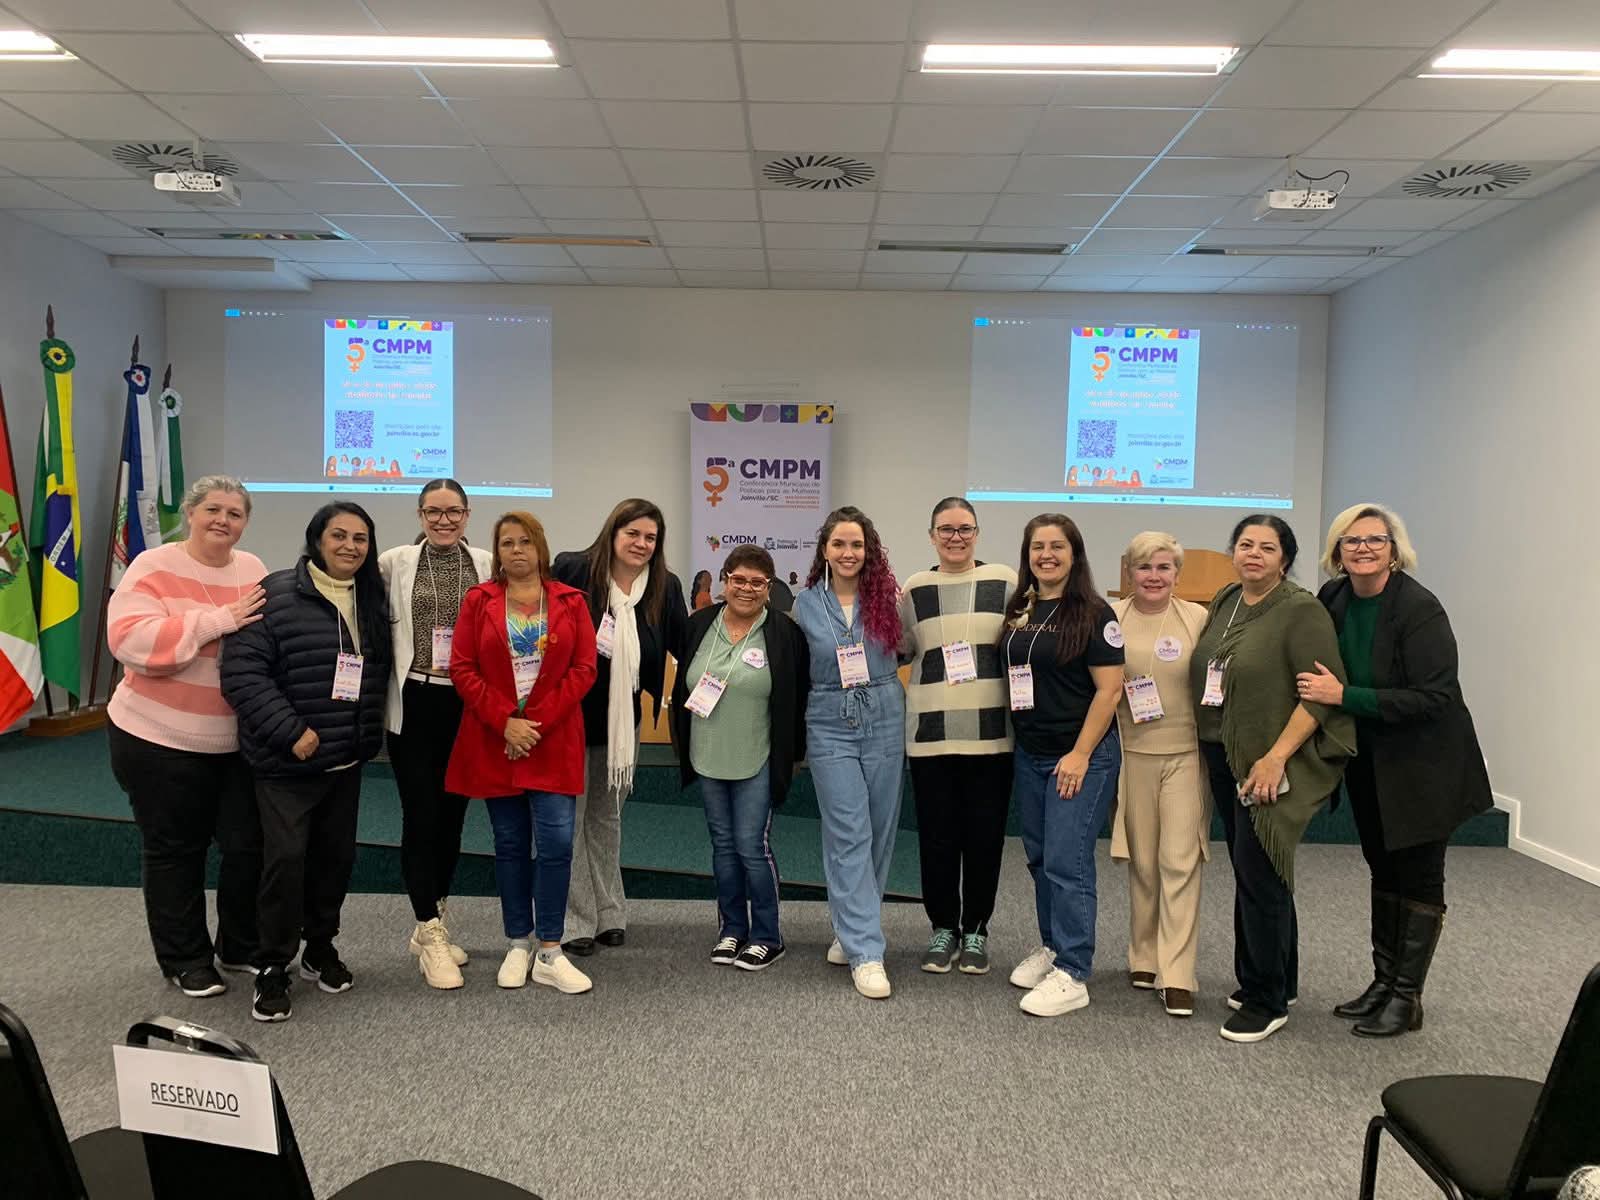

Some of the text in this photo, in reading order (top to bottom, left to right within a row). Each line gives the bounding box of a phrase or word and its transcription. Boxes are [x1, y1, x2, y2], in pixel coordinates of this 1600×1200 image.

[372, 338, 432, 354] CMPM
[1118, 347, 1178, 363] CMPM
[740, 459, 820, 480] CMPM
[722, 535, 757, 544] CMDM
[1135, 681, 1153, 690] CMPM
[151, 1082, 239, 1112] RESERVADO
